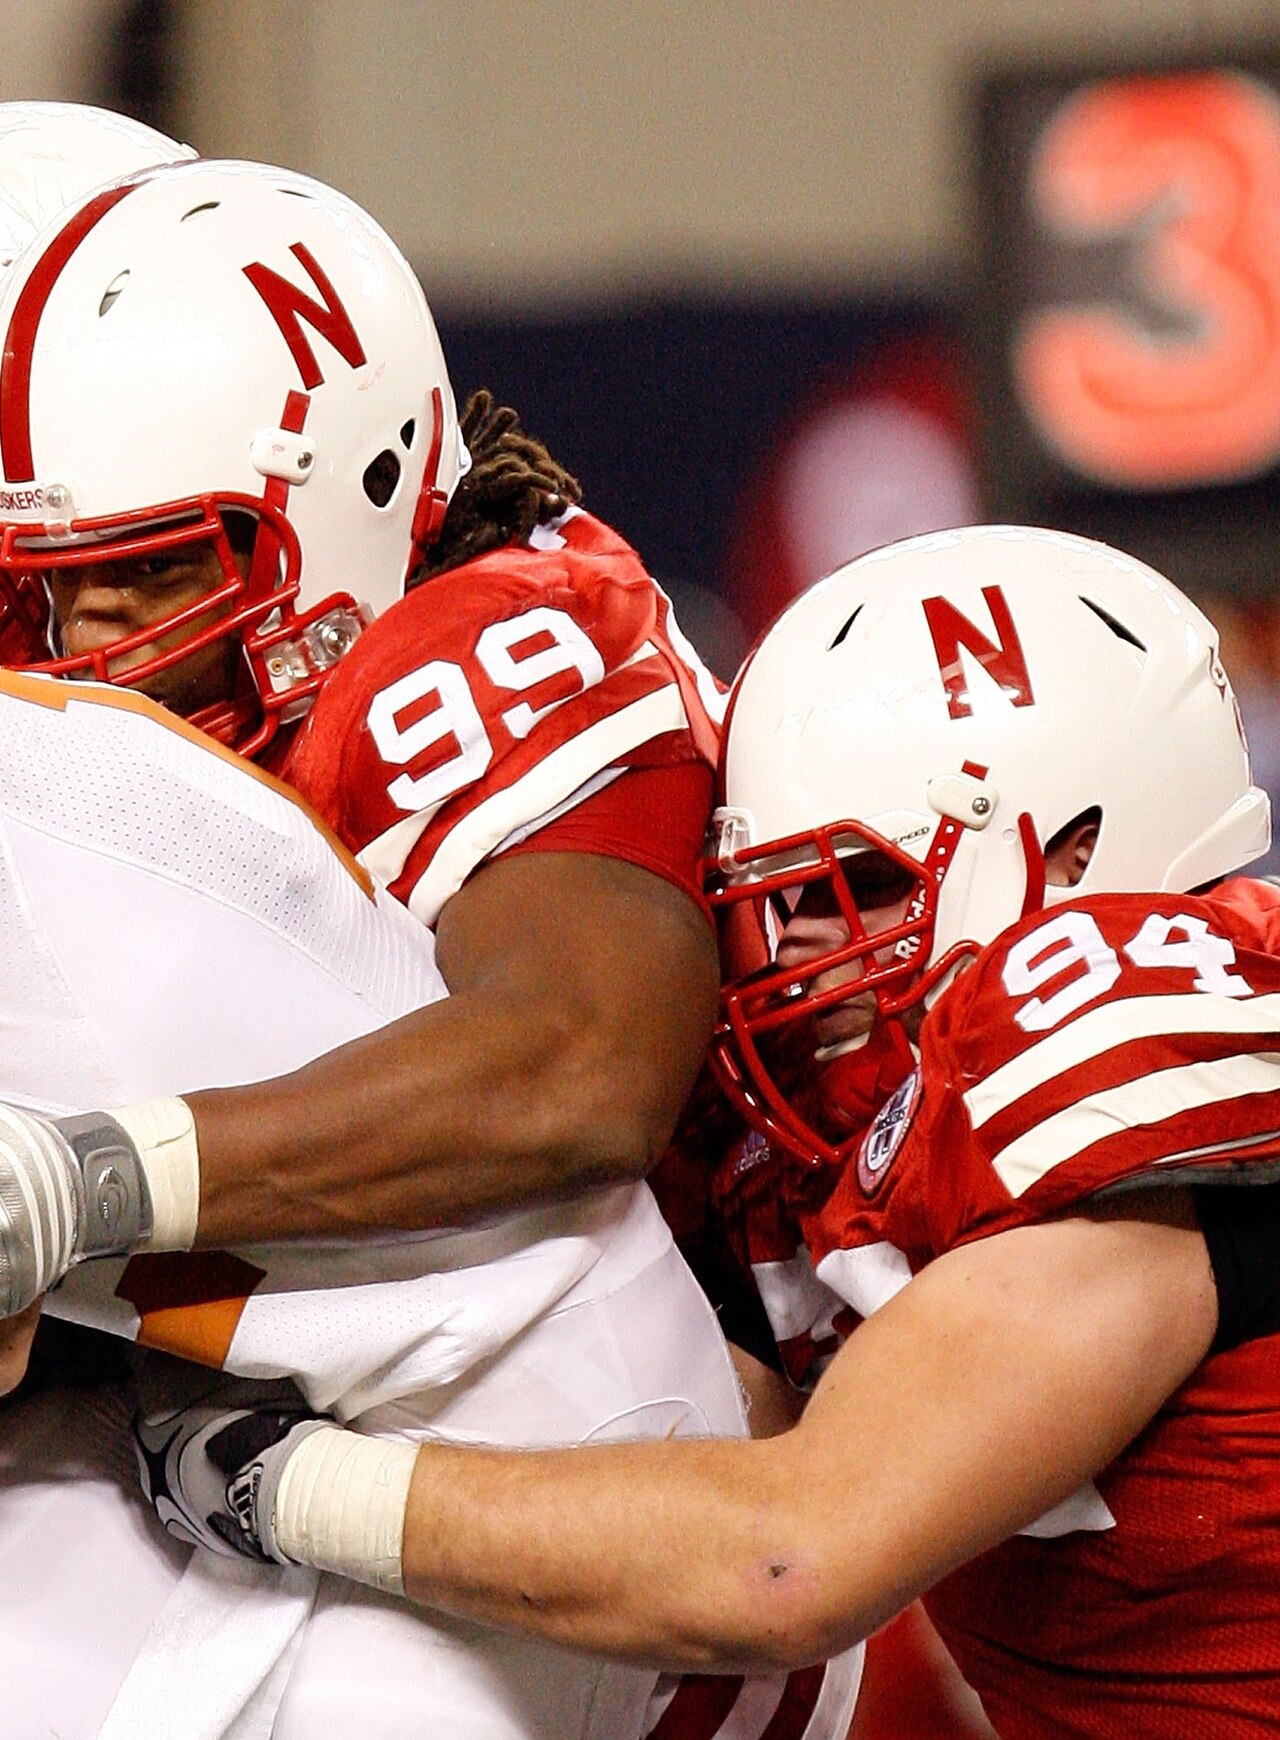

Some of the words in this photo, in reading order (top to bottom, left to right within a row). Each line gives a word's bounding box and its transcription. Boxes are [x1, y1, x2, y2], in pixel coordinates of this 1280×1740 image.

[241, 241, 367, 391] N
[1017, 70, 1280, 488] 3
[366, 605, 606, 812] 99
[922, 585, 1035, 720] N
[1001, 910, 1255, 1033] 94
